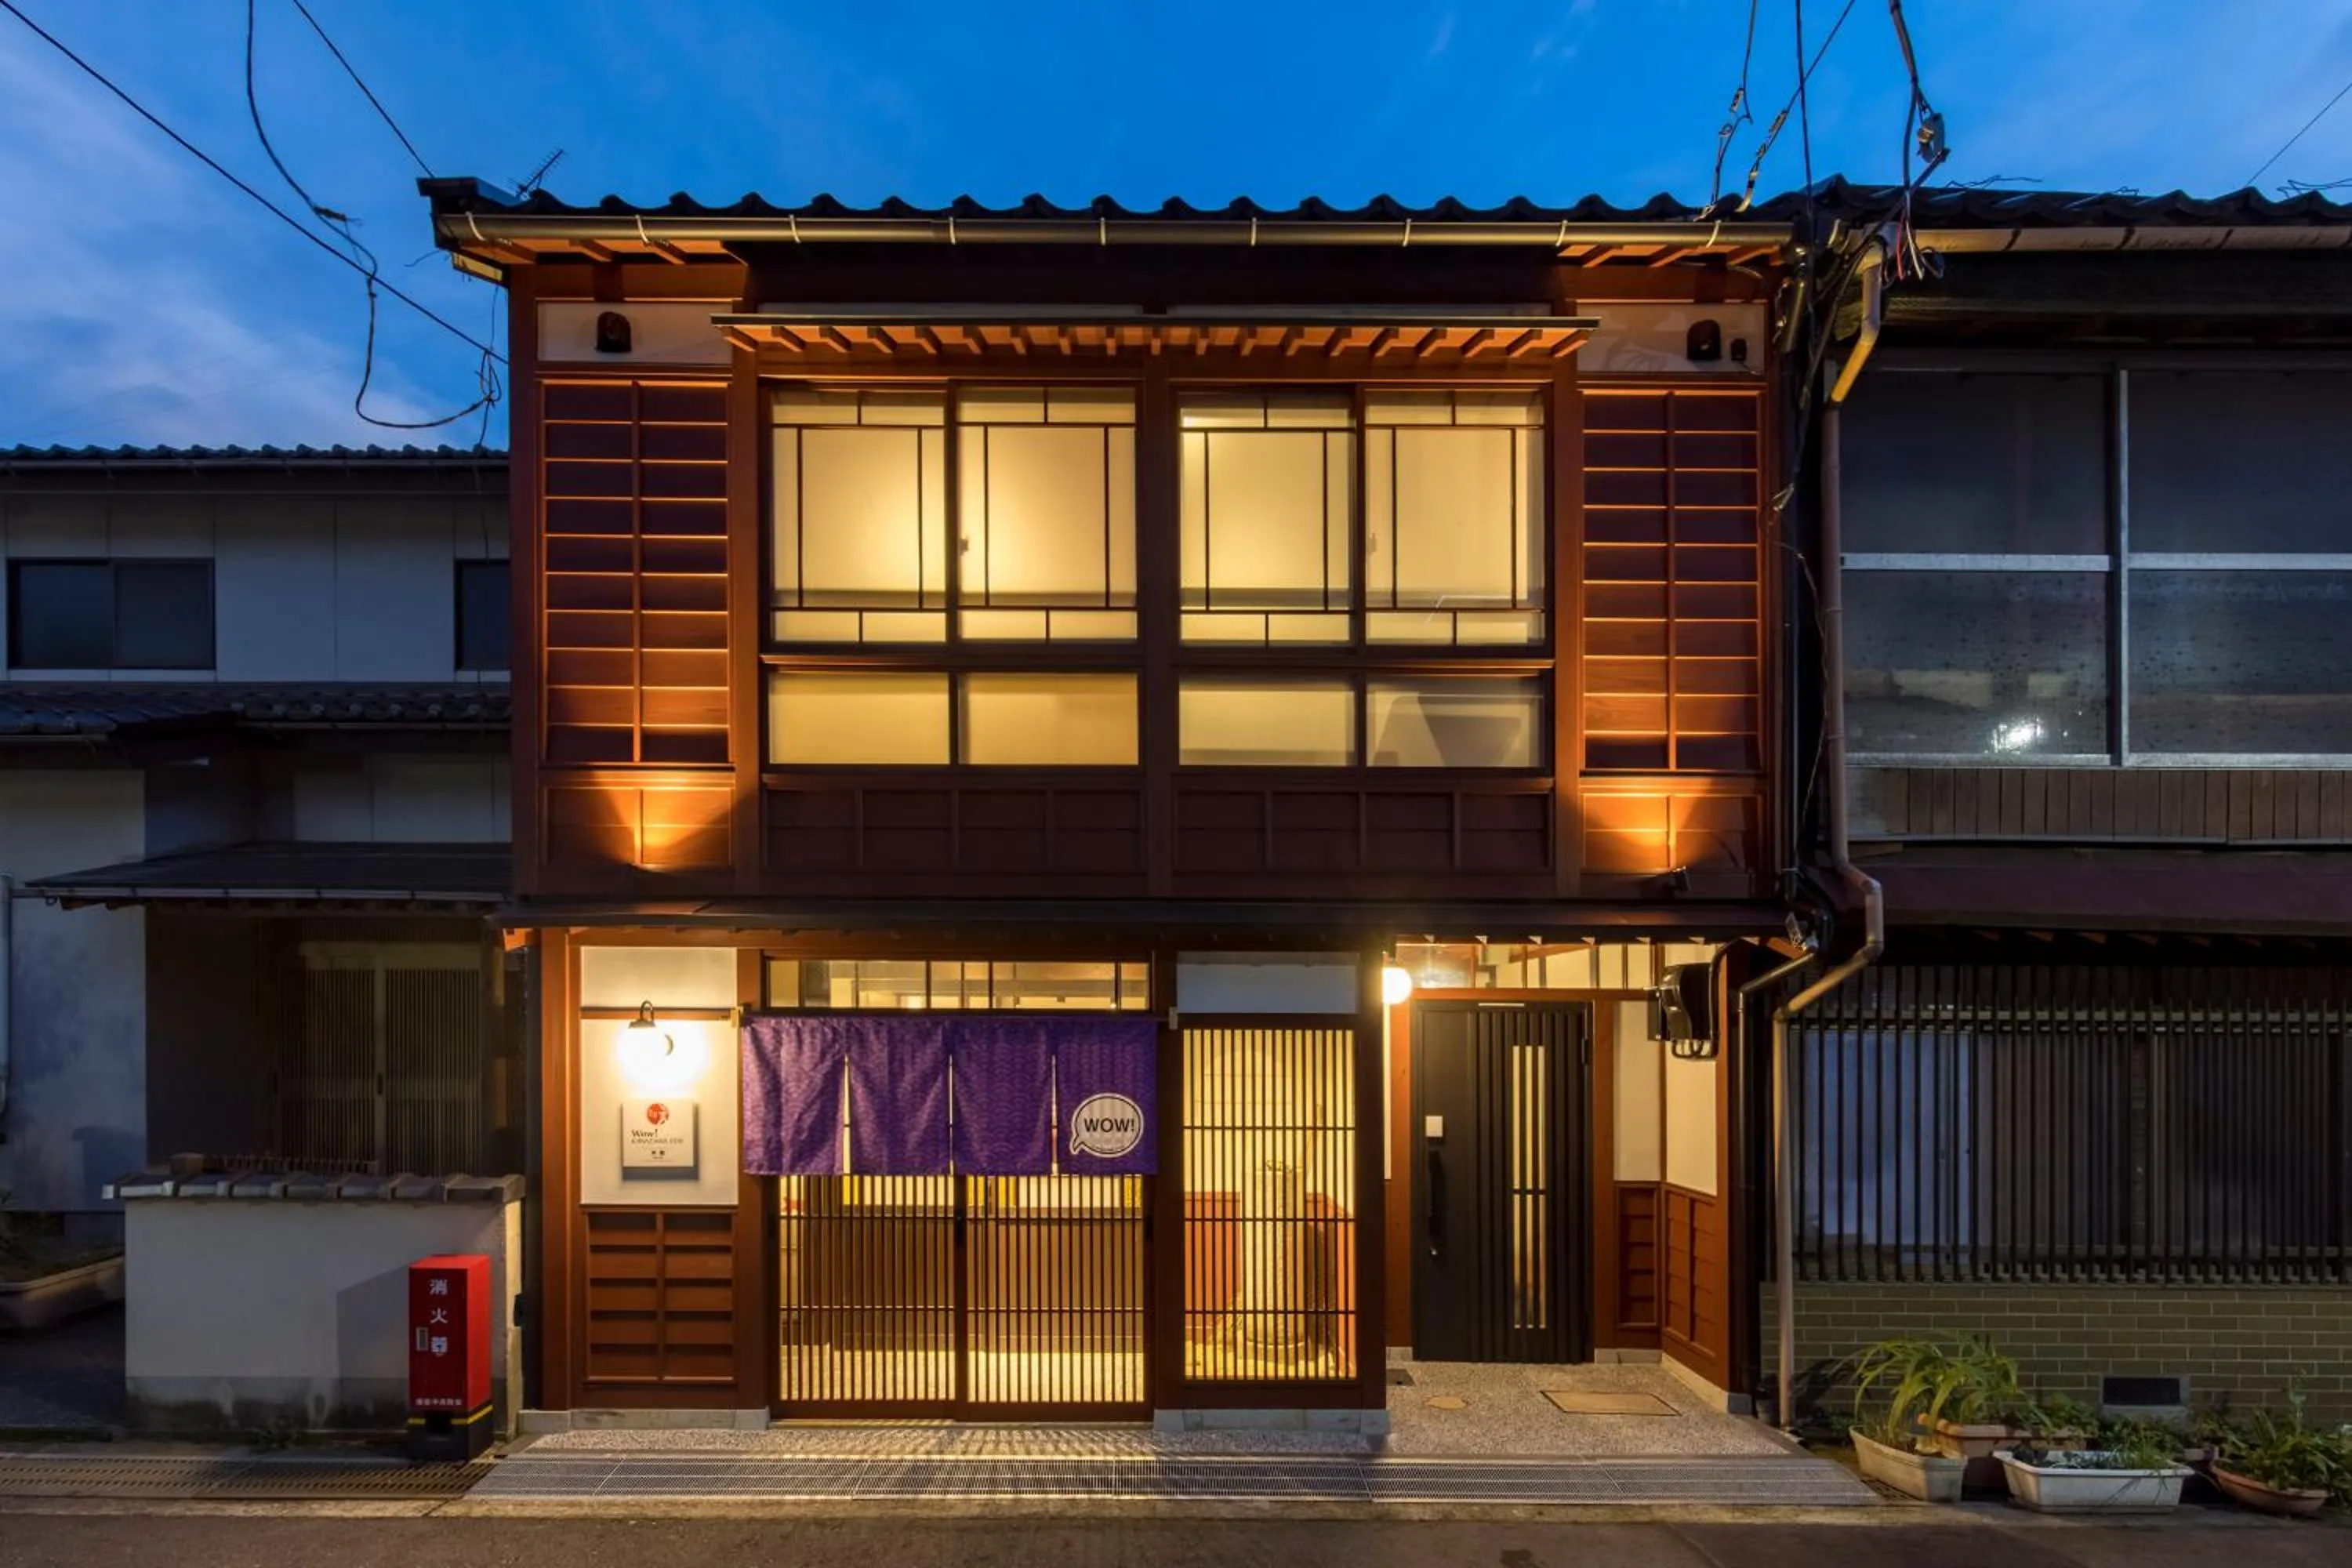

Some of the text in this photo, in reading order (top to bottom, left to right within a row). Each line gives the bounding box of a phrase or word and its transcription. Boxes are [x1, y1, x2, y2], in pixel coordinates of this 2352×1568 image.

[1083, 1118, 1135, 1133] WOW!
[430, 1279, 448, 1353] 消火器
